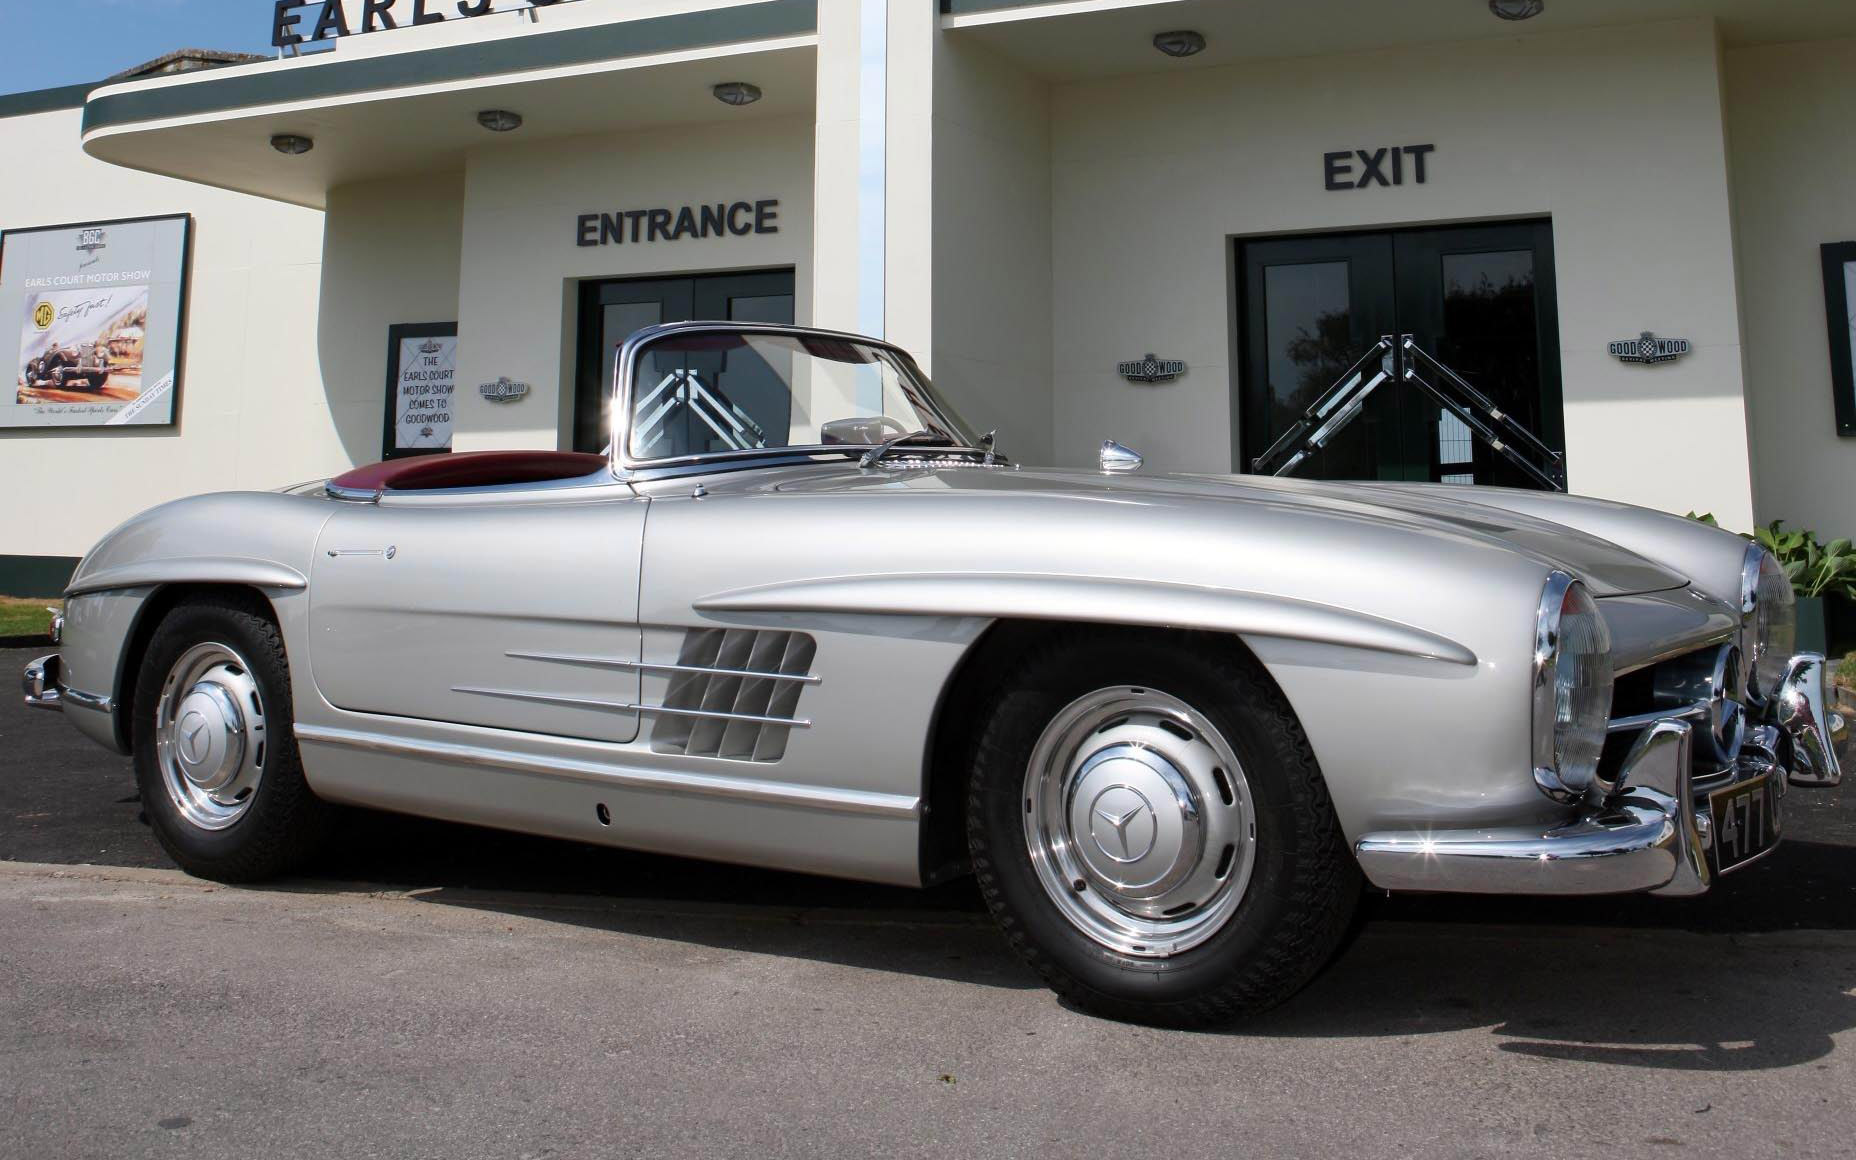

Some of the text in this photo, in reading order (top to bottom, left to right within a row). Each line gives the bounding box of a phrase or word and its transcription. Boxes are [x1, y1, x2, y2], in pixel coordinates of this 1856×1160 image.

[1324, 144, 1435, 191] EXIT
[576, 199, 779, 247] ENTRANCE
[83, 229, 101, 245] BGC
[25, 270, 151, 288] EARLS COURT MOTOR SHOW
[35, 304, 53, 327] MG
[1610, 340, 1687, 355] GOOD WOOD
[423, 356, 438, 366] THE
[1119, 361, 1183, 375] GOOD WOOD
[403, 369, 455, 381] EARLS COURT
[403, 384, 455, 396] MOTOR SHOW
[409, 398, 447, 410] COMES TO
[405, 412, 450, 425] GOODWOOD
